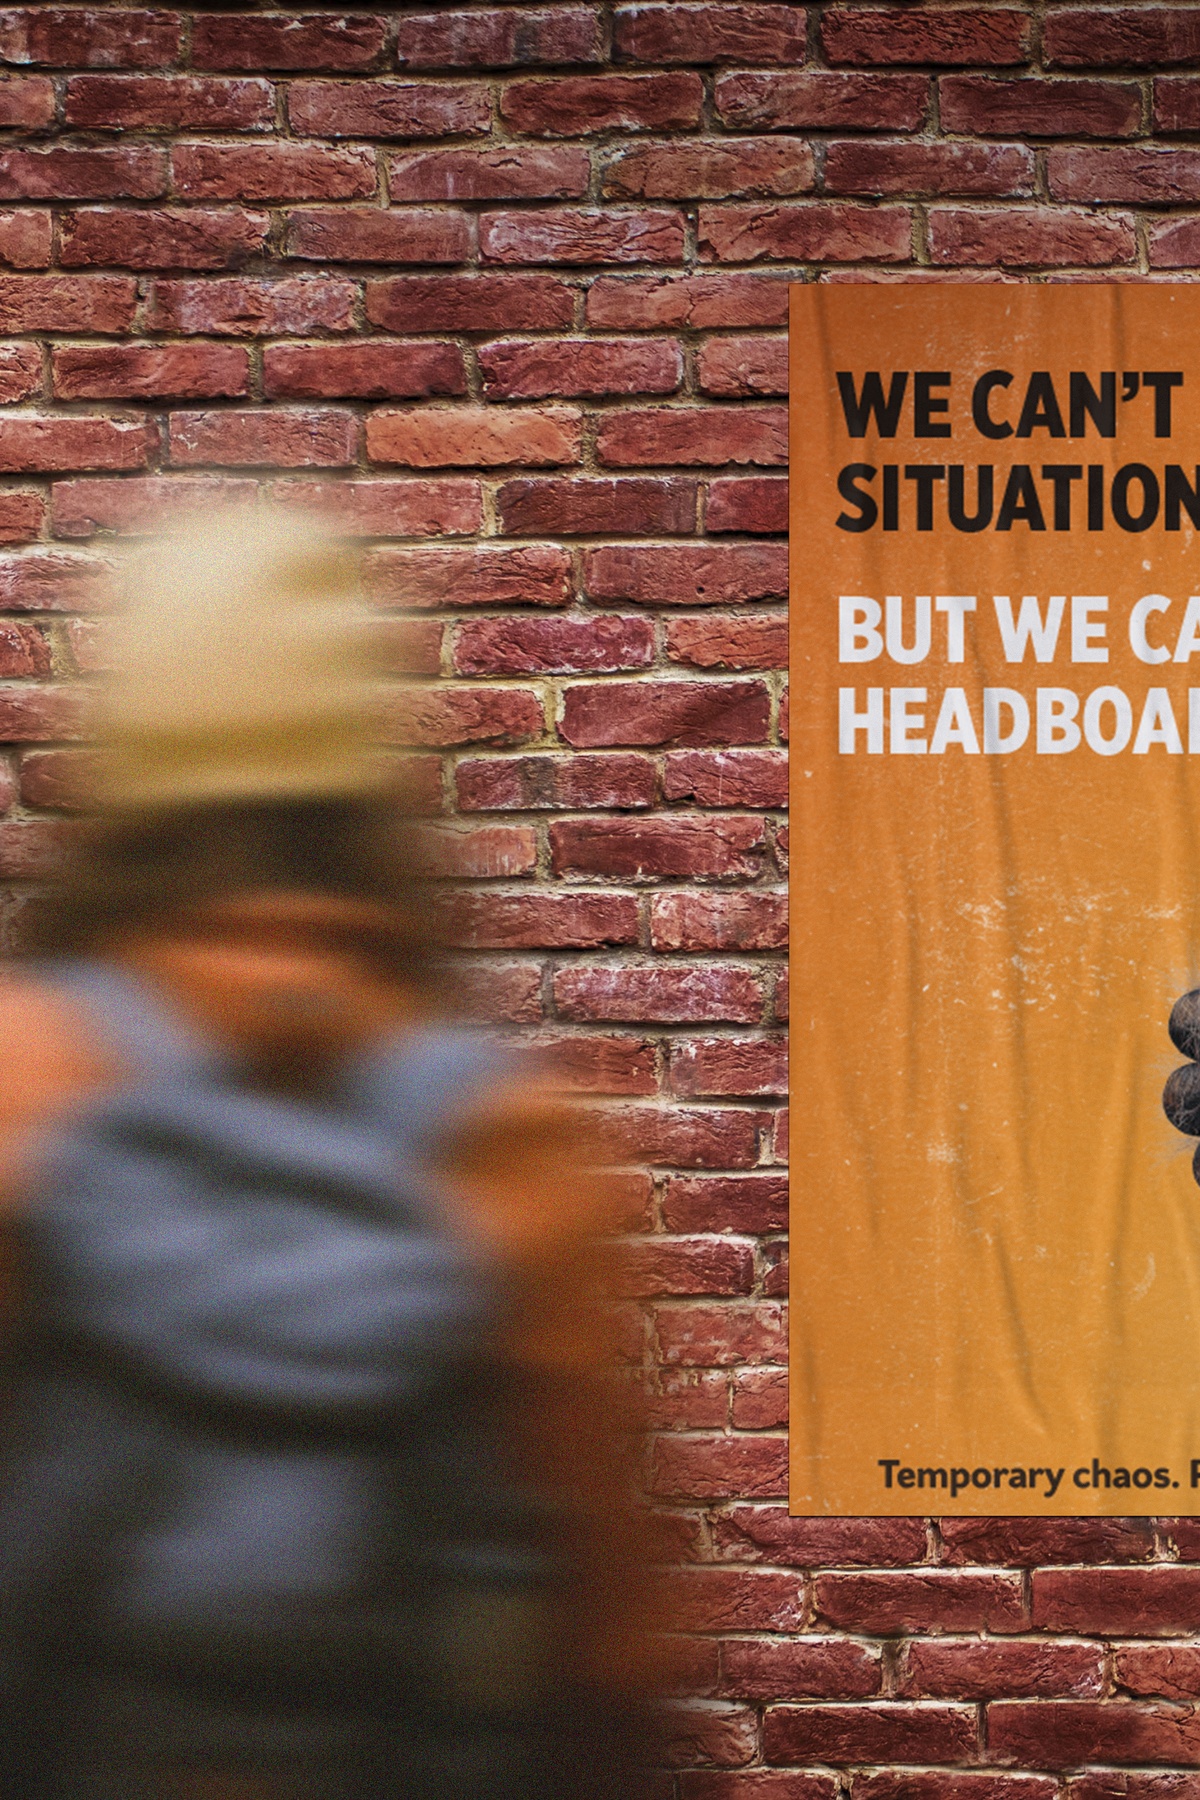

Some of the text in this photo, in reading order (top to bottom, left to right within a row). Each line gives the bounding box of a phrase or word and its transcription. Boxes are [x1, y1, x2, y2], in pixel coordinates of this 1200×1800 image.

[836, 371, 952, 439] WE
[971, 370, 1184, 440] CAN’T
[838, 595, 977, 665] BUT
[993, 595, 1109, 663] WE
[878, 1458, 1065, 1498] Temporary
[1073, 1458, 1180, 1489] chaos.
